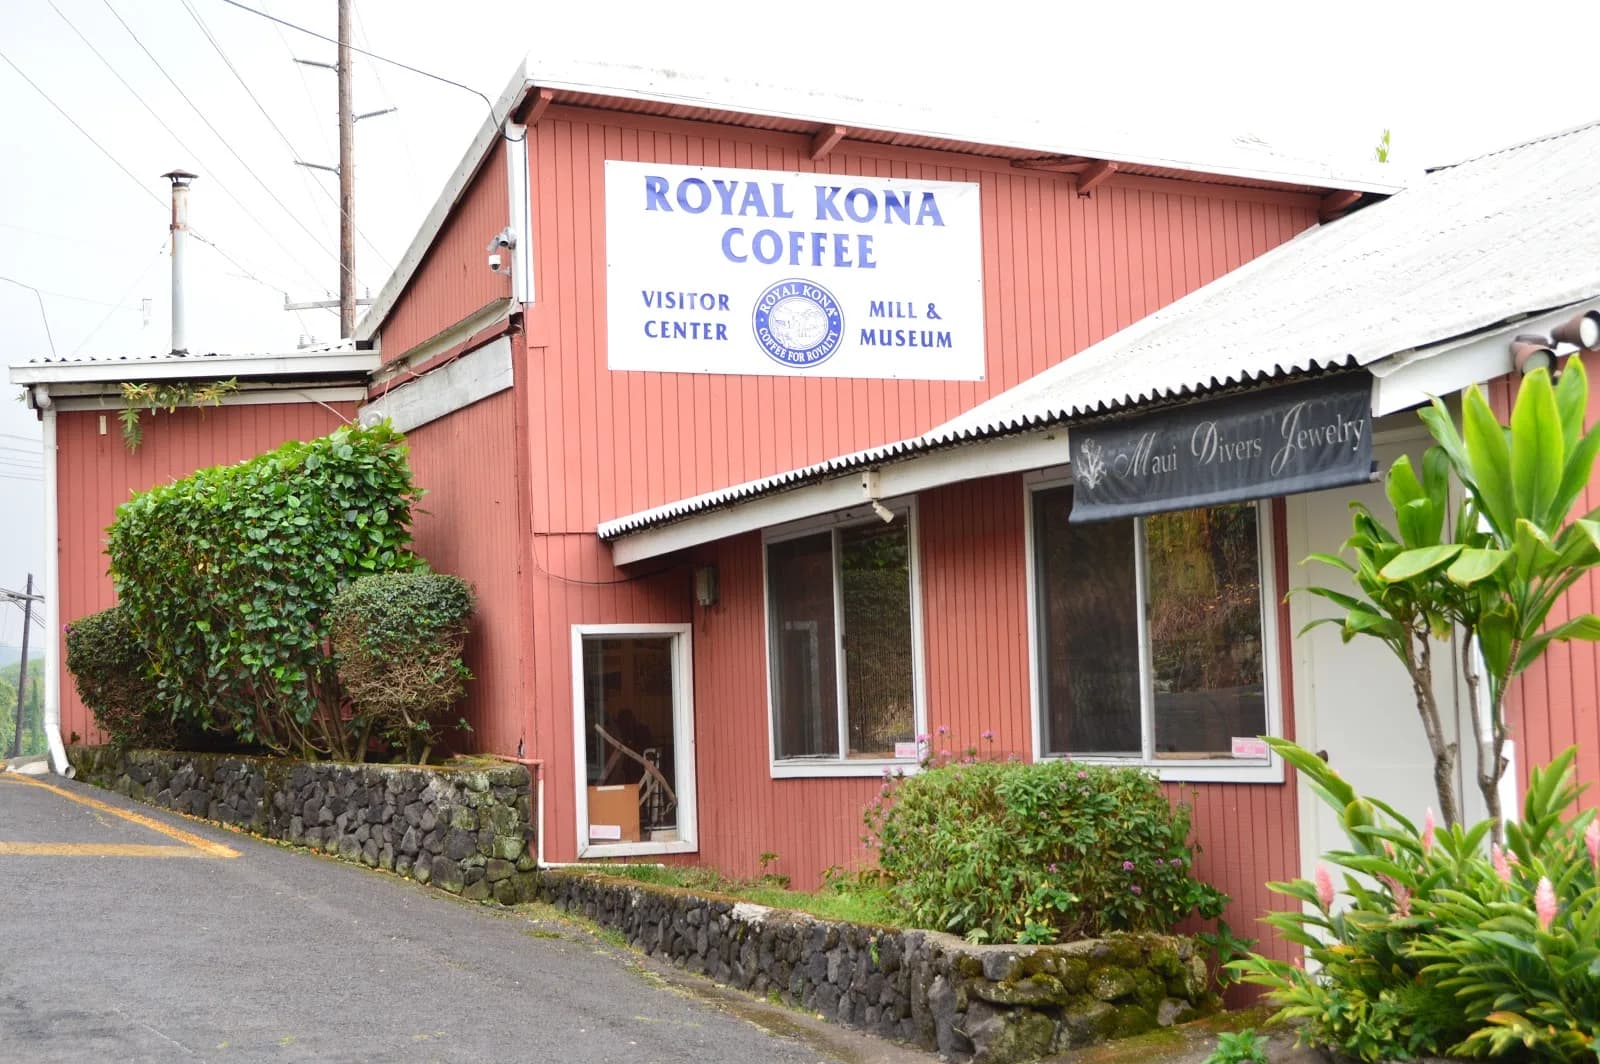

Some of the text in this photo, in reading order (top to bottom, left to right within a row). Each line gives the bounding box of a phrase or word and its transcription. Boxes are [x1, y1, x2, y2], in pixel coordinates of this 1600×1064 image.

[644, 175, 945, 227] ROYAL KONA
[721, 227, 877, 269] COFFEE
[641, 290, 730, 312] VISITOR
[759, 284, 799, 314] ROYAL
[869, 300, 943, 320] MILL &
[644, 320, 729, 341] CENTER
[759, 327, 839, 363] COFFEE FOR ROYALTY
[859, 328, 953, 348] MUSEUM
[1114, 401, 1365, 479] Maui Divers Jewelry
